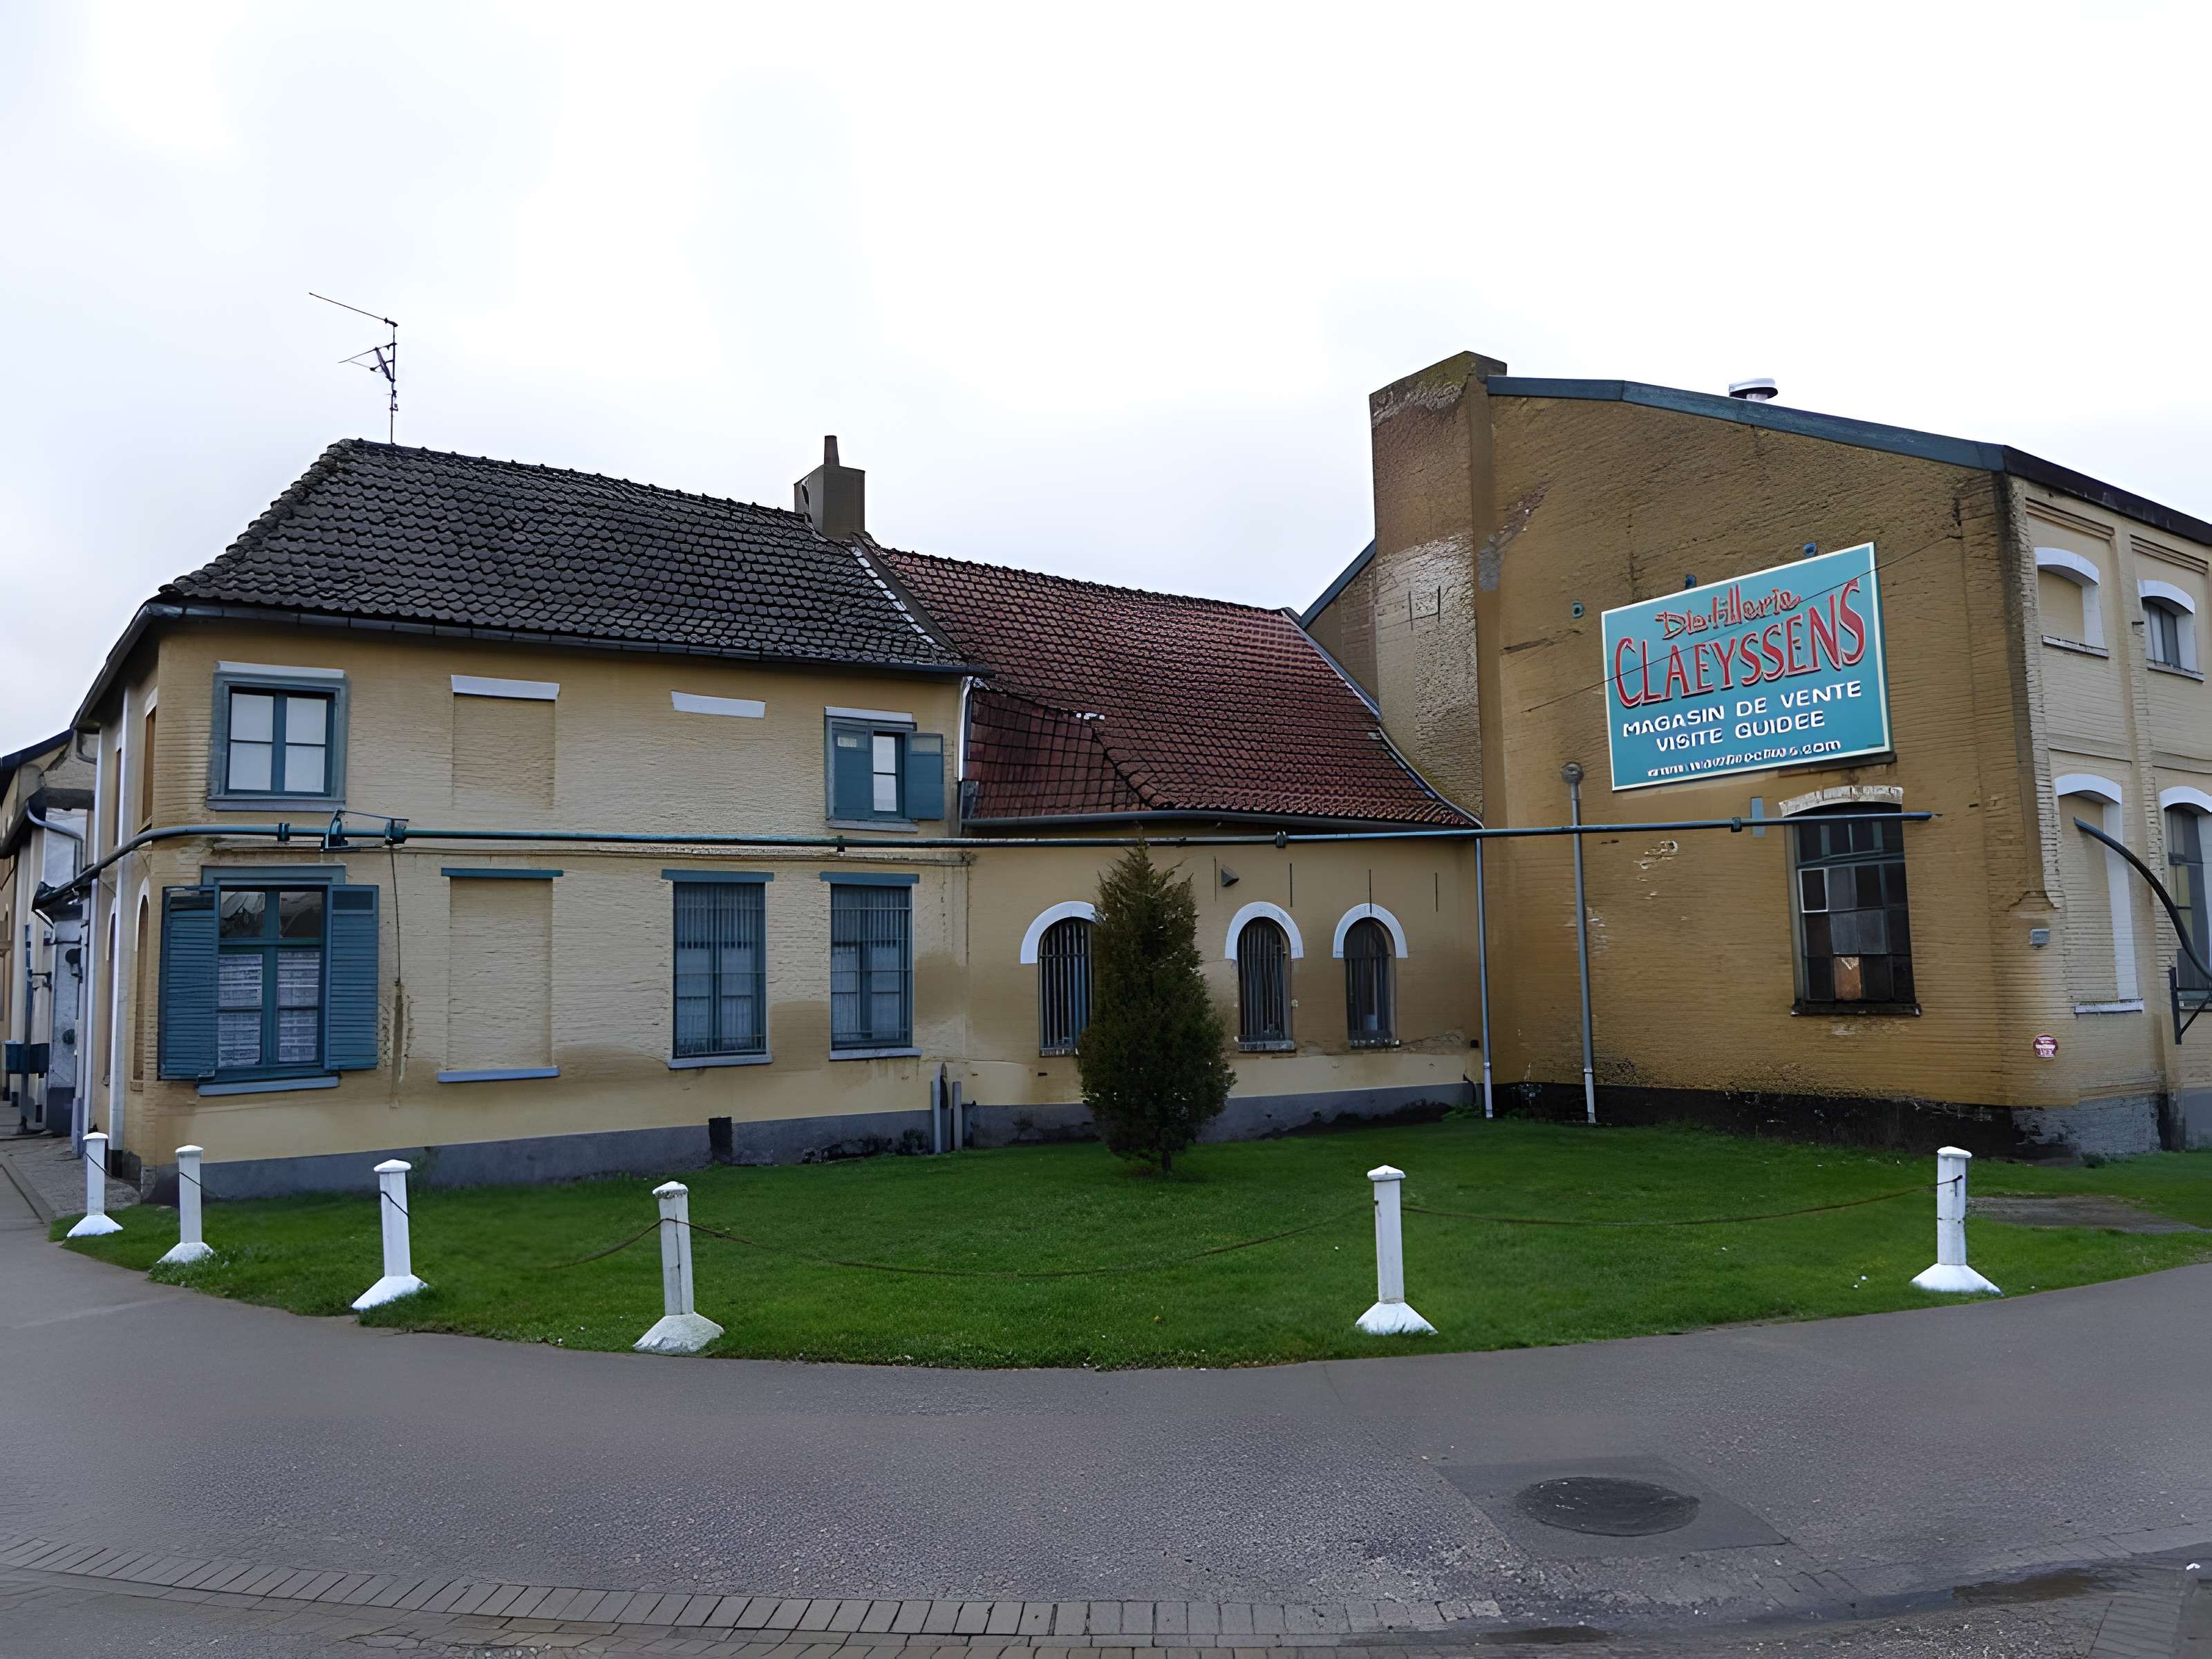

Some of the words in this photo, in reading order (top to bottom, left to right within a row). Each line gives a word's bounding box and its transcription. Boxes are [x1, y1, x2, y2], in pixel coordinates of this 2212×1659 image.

[1615, 578, 1866, 709] CLAEYSSENS
[1623, 705, 1725, 738] MAGASIN
[1736, 698, 1767, 718] DE
[1780, 680, 1862, 709] VENTE
[1656, 727, 1723, 752] VISITE
[1734, 711, 1825, 739] GUIDEE
